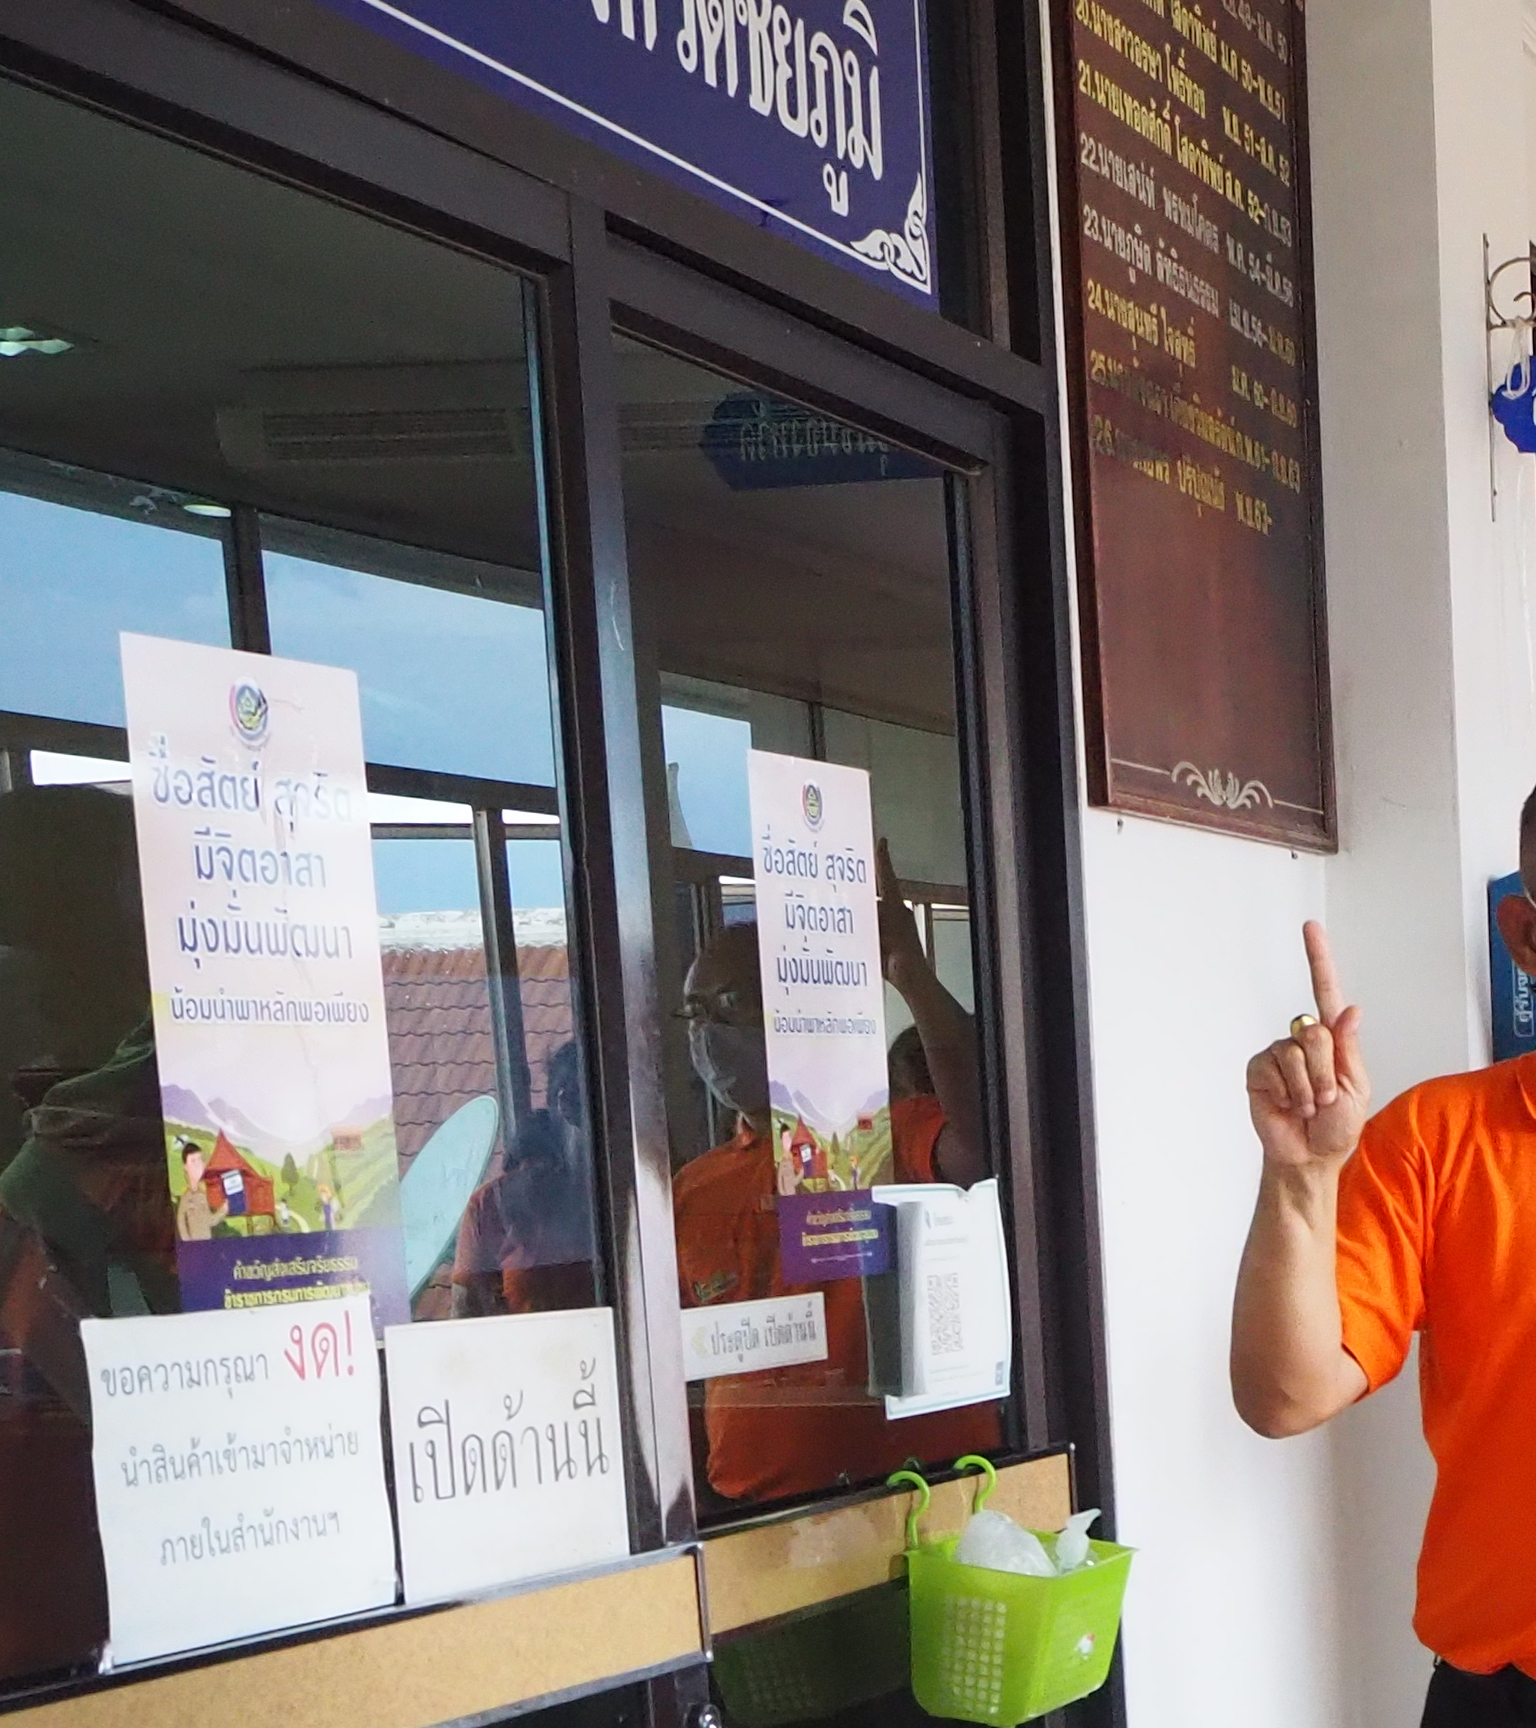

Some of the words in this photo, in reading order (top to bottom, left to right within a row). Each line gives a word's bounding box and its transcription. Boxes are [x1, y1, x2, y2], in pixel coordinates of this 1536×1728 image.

[193, 826, 328, 889] มีจิตอาสา
[825, 847, 867, 893] สุจริต
[177, 889, 353, 969] มุ่งมั่นพัฒนา
[784, 890, 855, 935] มีจิตอาสา
[776, 935, 868, 996] มุ่งมั่นพัฒนา
[170, 986, 370, 1023] น้อมนำพาหลักพอเพียง
[100, 1353, 269, 1400] ขอความกรุณา
[283, 1310, 355, 1381] งด!
[120, 1424, 359, 1488] นำสินค้าเข้ามาจำหน่าย
[409, 1357, 611, 1504] เปิดด้านนี้
[160, 1508, 341, 1567] ภายในสำนักงานฯ
